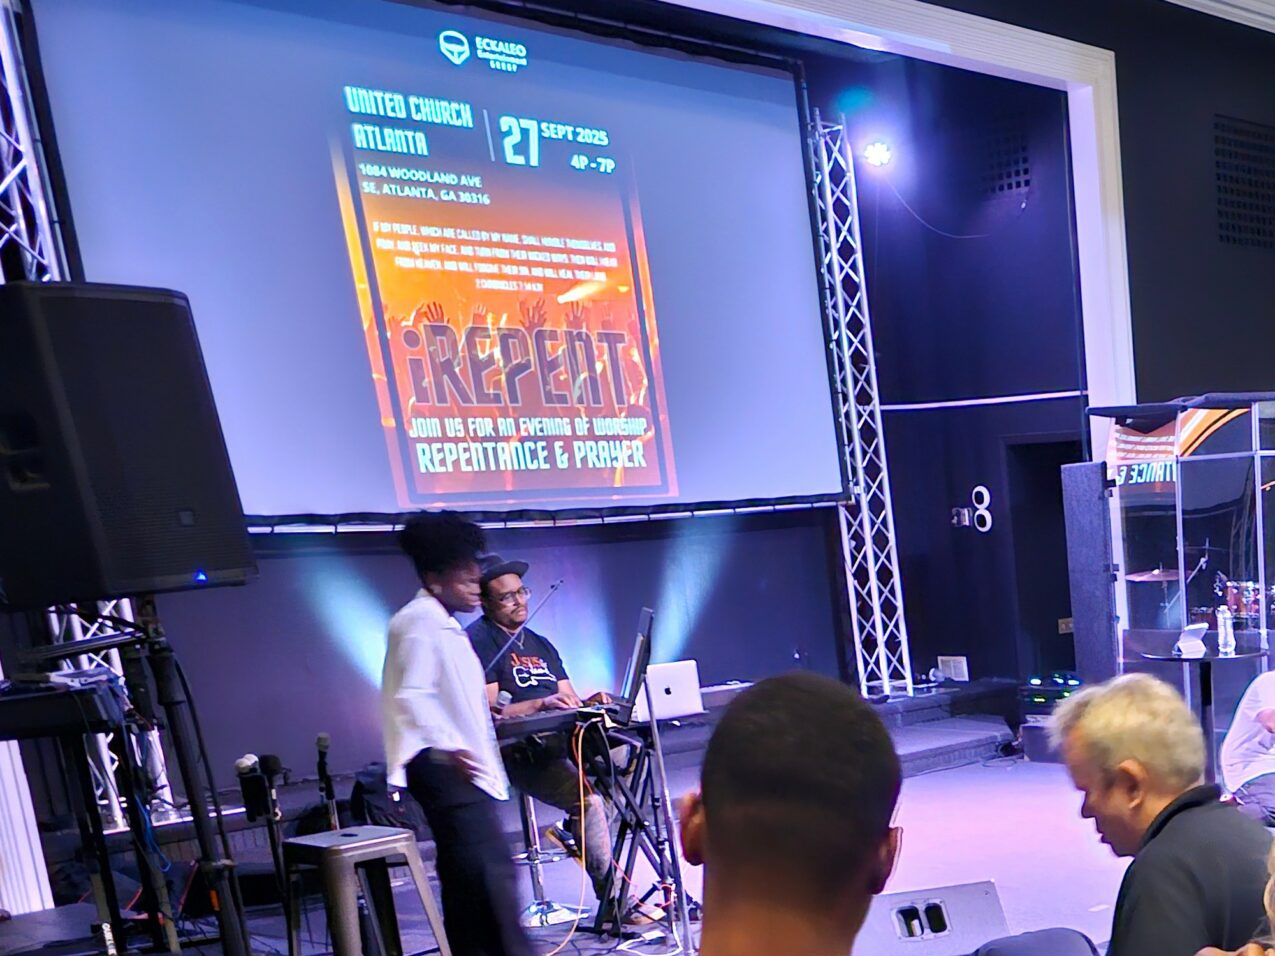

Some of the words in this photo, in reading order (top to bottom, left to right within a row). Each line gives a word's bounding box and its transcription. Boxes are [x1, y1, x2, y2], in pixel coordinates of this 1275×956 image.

[475, 36, 527, 57] ECKALEO
[344, 86, 407, 119] UNITED
[408, 95, 474, 128] CHURCH
[352, 123, 429, 156] ATLANTA
[499, 115, 540, 167] 27
[541, 122, 575, 141] SEPT
[576, 127, 609, 146] 2025
[389, 167, 459, 185] WOODLAND
[460, 175, 482, 188] AVE
[570, 154, 589, 171] 4P
[597, 157, 616, 174] 7P
[362, 181, 381, 195] SE,
[382, 184, 438, 201] ATLANTA,
[440, 190, 457, 201] GA
[458, 191, 491, 206] 30316
[403, 323, 628, 407] iREPENT
[409, 417, 442, 438] JOIN
[444, 417, 465, 438] US
[467, 417, 496, 437] FOR
[497, 417, 517, 437] AN
[519, 417, 572, 437] EVENING
[574, 417, 591, 436] OF
[592, 417, 648, 436] WORSHIP
[416, 441, 551, 473] REPENTANCE
[553, 441, 569, 470] &
[573, 440, 648, 469] PRAYER
